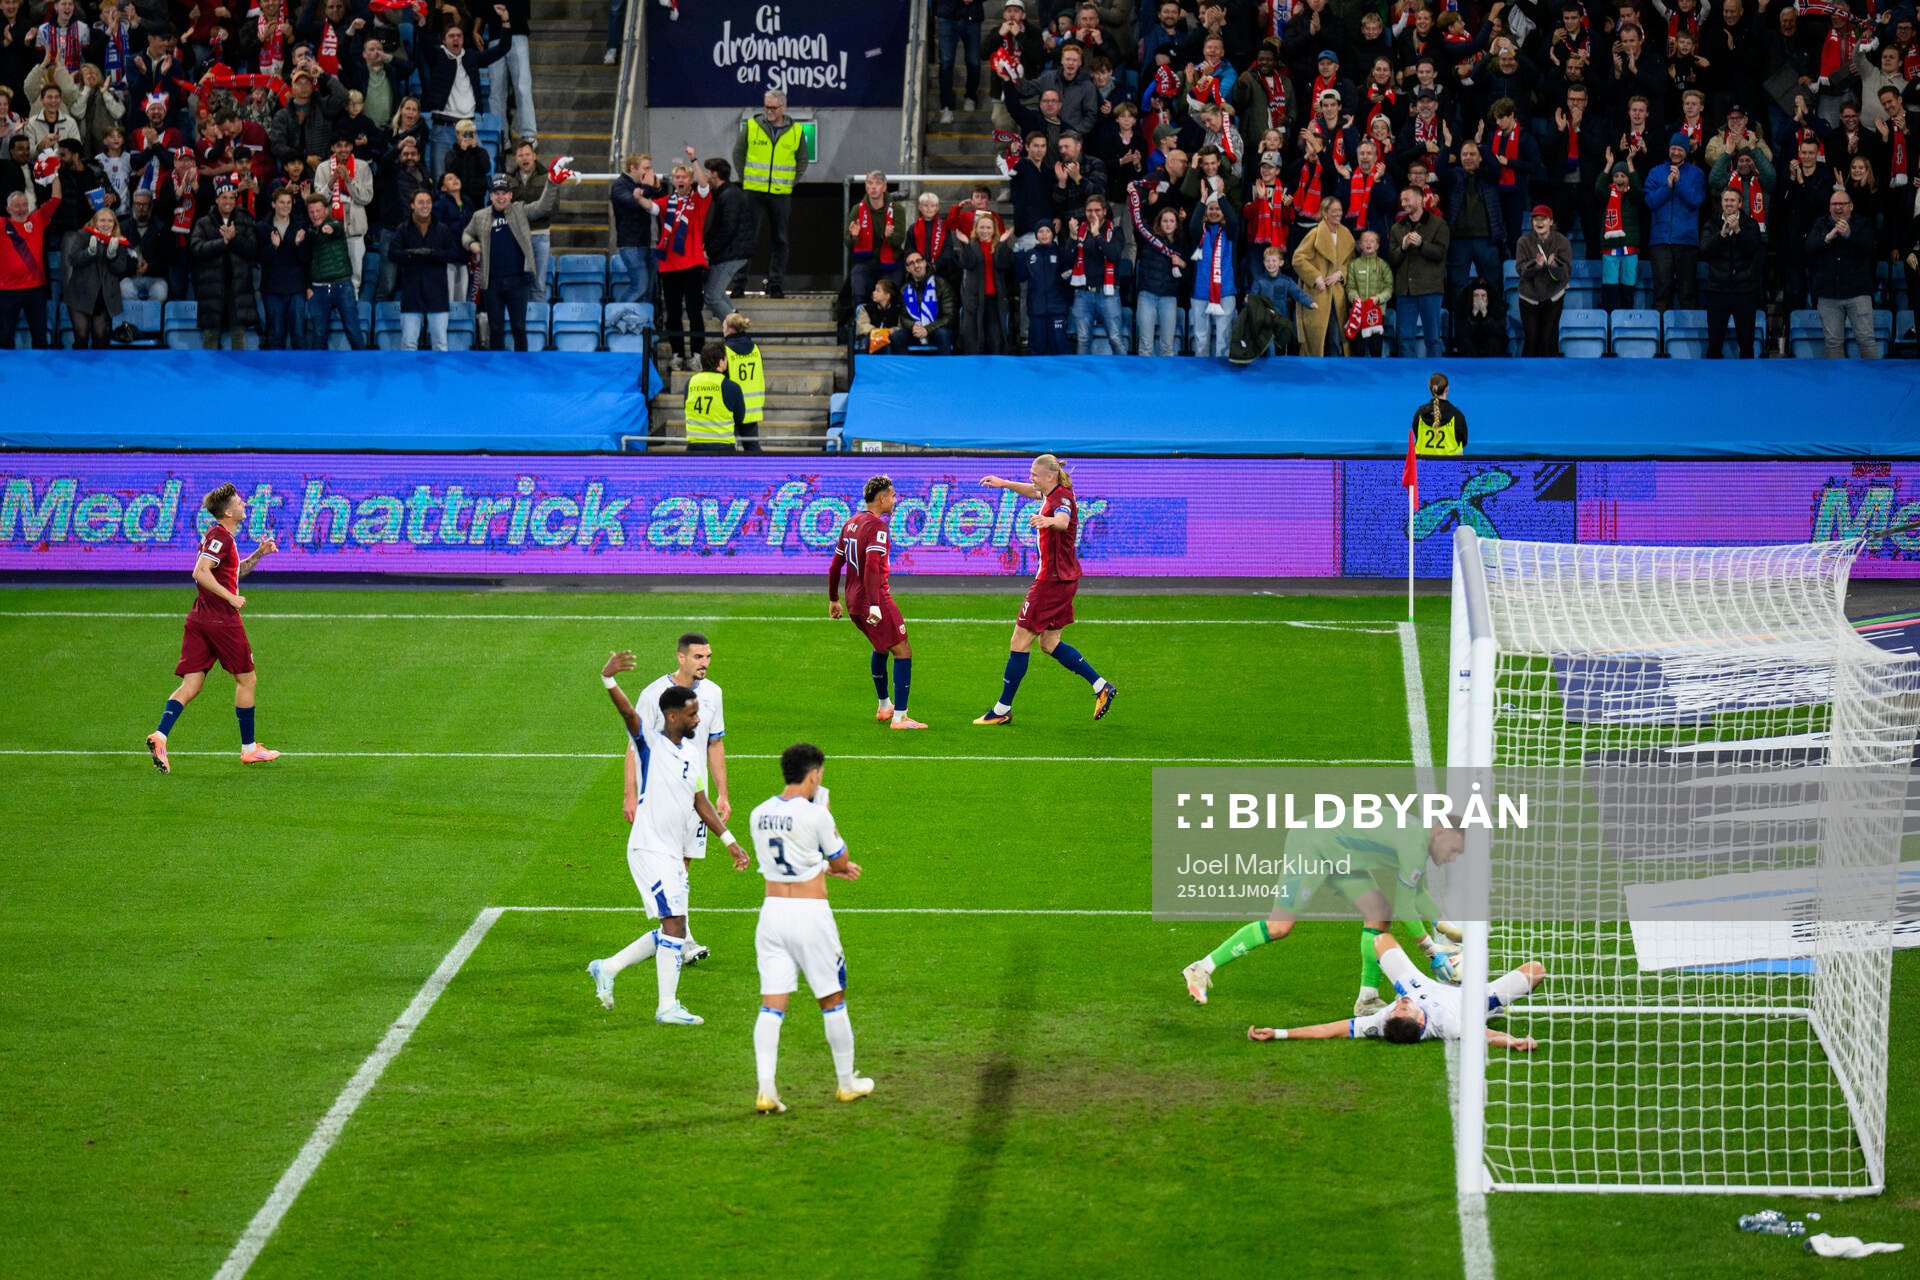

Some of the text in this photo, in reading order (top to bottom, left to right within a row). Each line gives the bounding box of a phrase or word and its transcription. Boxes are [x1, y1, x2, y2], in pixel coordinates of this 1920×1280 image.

[755, 4, 781, 35] Gi
[712, 20, 829, 68] drømmen
[736, 50, 849, 97] en sjanse!
[738, 362, 756, 381] 67
[690, 385, 720, 393] STEWARD
[693, 396, 714, 415] 47
[1425, 429, 1446, 449] 22
[0, 477, 184, 543] Med
[296, 476, 632, 545] hattrick
[646, 494, 750, 548] av
[683, 761, 689, 779] 2
[696, 821, 706, 838] 21
[758, 815, 793, 832] REVIVO
